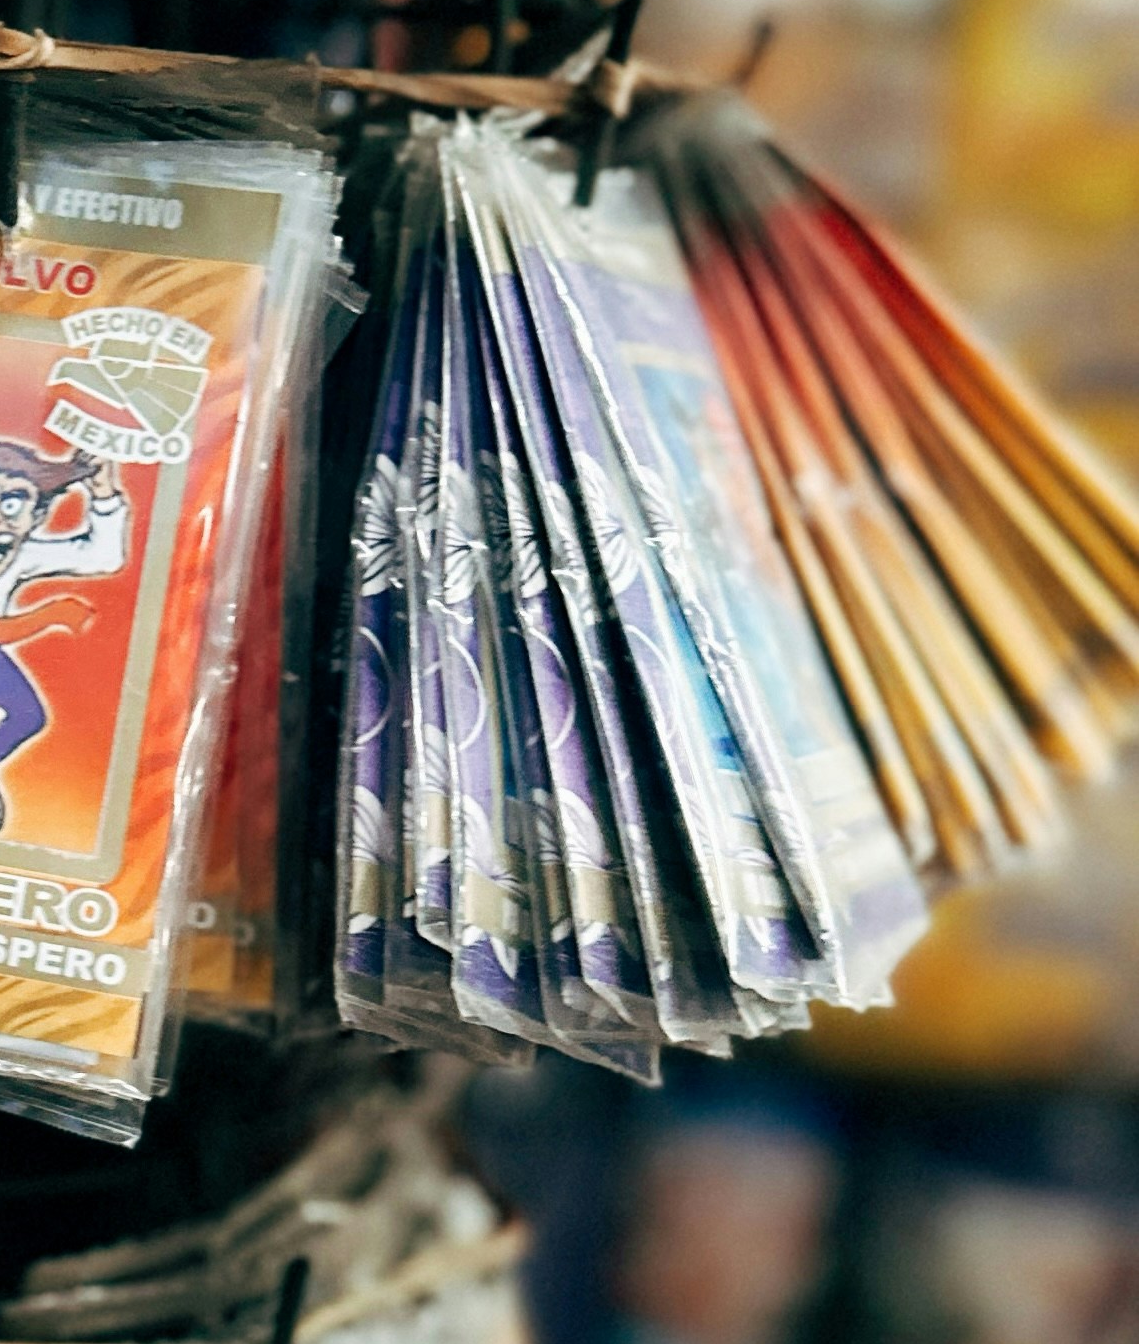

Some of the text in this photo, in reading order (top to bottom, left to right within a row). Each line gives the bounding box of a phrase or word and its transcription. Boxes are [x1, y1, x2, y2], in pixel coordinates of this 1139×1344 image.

[56, 186, 184, 230] EFECTIVO
[68, 310, 208, 358] HECHO EN
[51, 407, 187, 459] MEXICO
